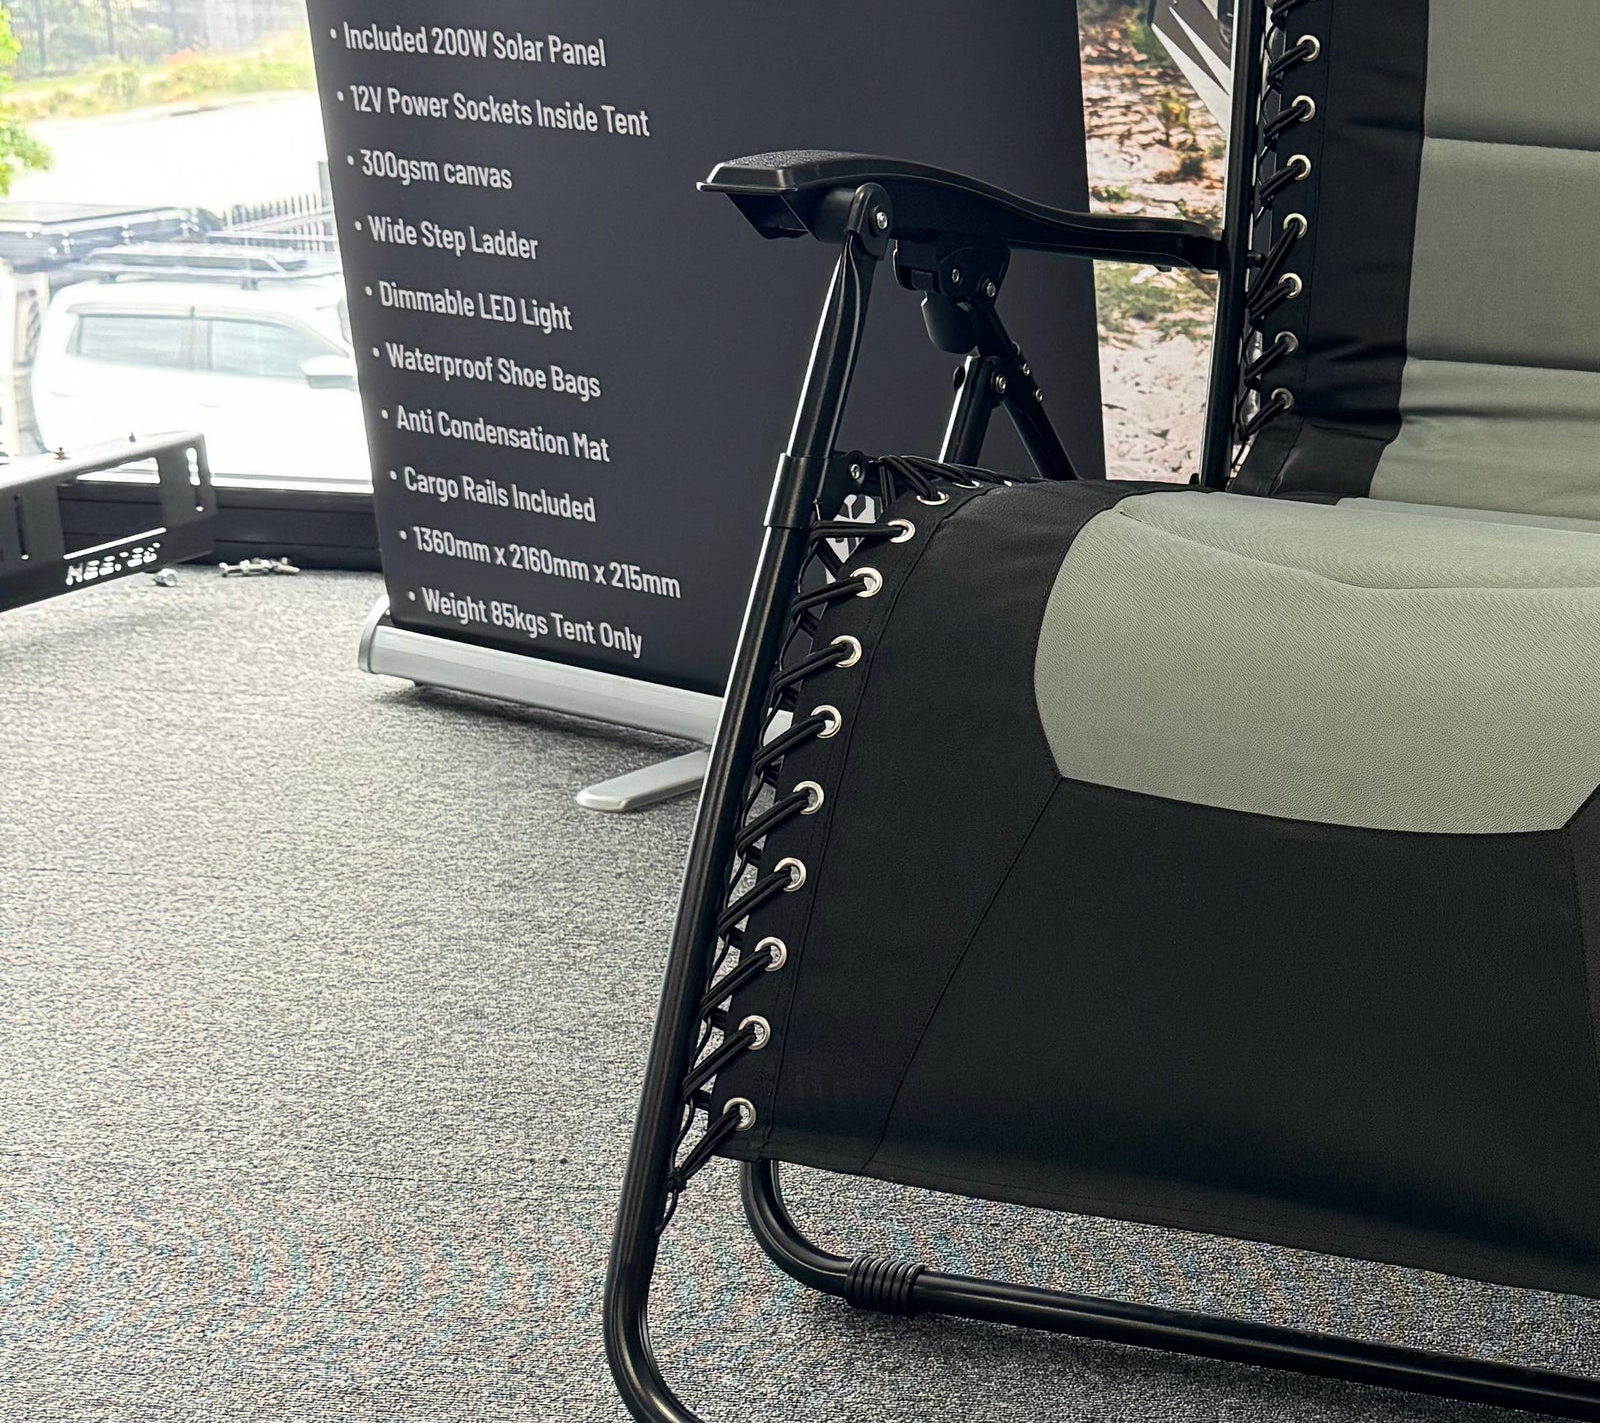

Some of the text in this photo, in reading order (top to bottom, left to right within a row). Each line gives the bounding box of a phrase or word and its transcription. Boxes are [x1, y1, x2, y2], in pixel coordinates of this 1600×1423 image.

[343, 21, 607, 67] Included 200W Solar Panel
[349, 84, 650, 137] 12V Power Sockets Inside Tent
[359, 148, 513, 190] 300gsm canvas
[367, 214, 539, 260] Wide Step Ladder
[378, 280, 573, 335] Dimmable LED Light
[385, 341, 601, 402] Waterproof Shoe Bags
[396, 404, 610, 463] Anti Condensation Mat
[404, 466, 596, 523] Cargo Rails Included
[412, 526, 681, 599] 1360mm x 2160mm x 215mm
[421, 586, 642, 659] Weight 85kgs Tent Only
